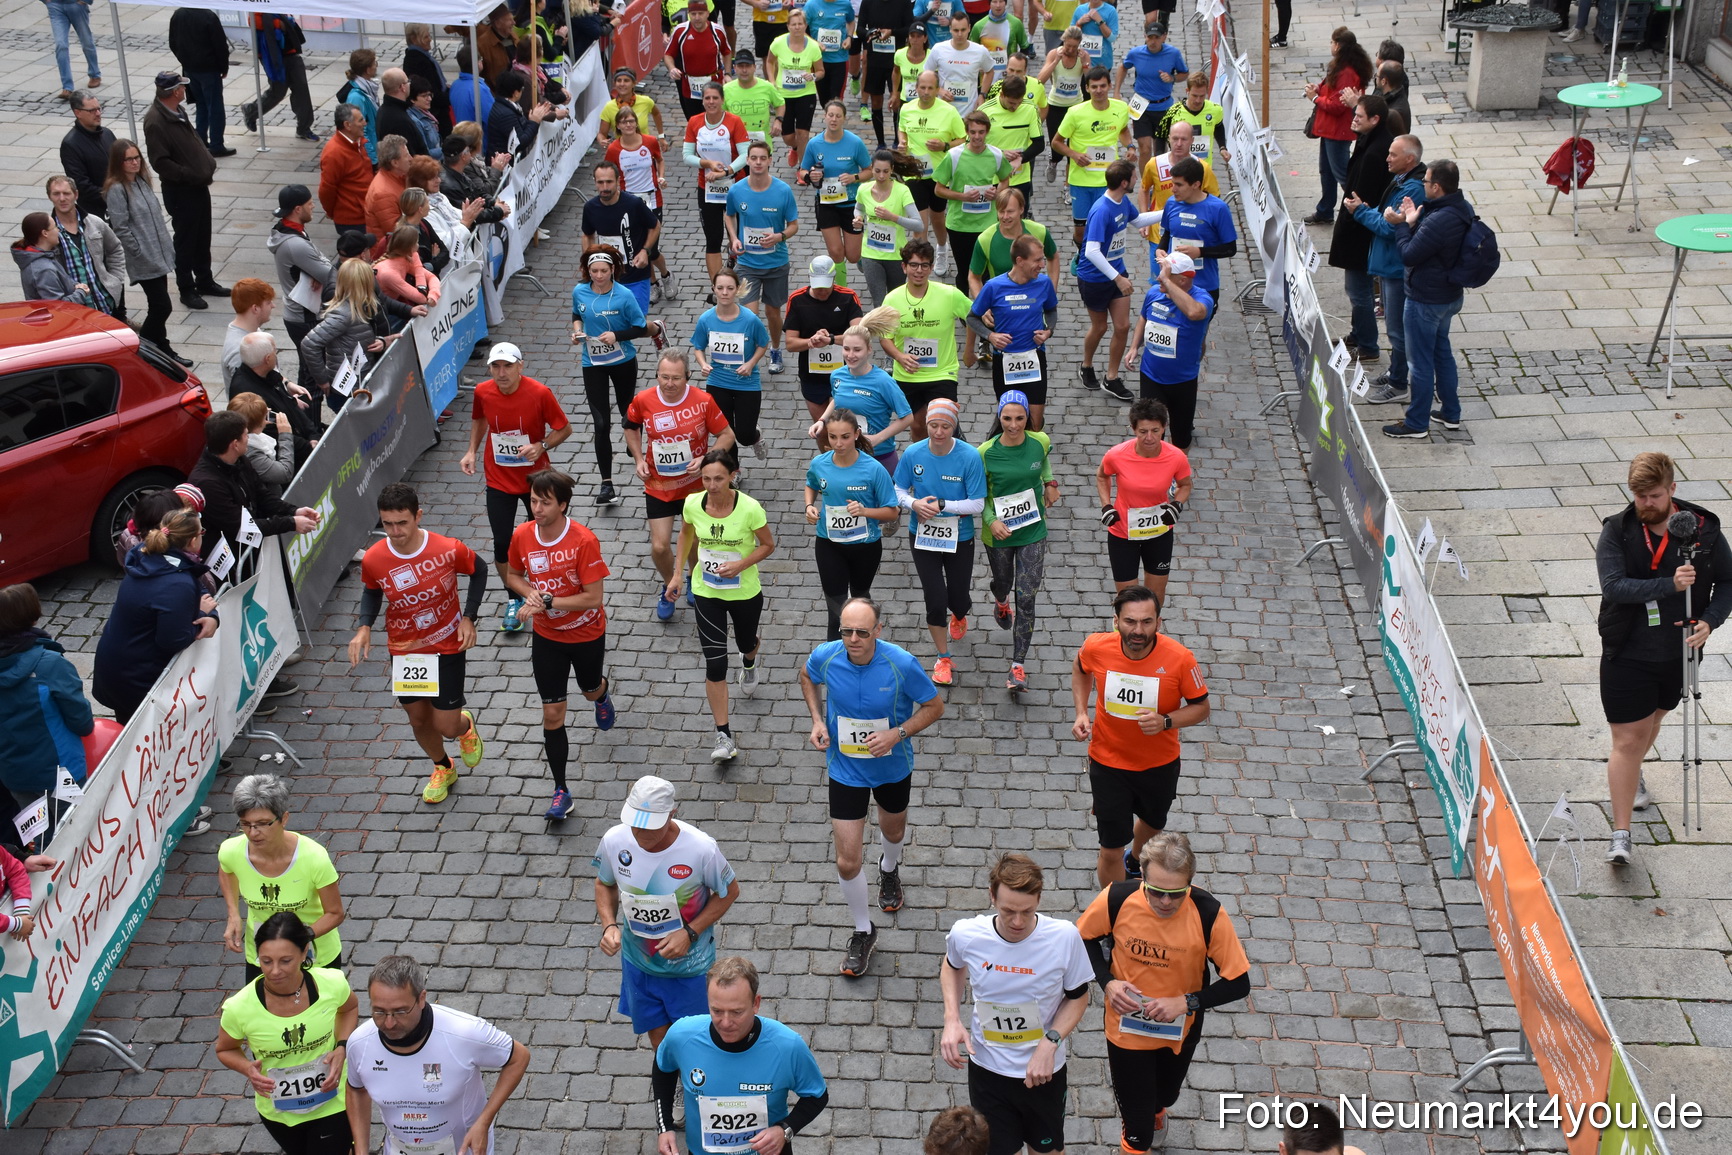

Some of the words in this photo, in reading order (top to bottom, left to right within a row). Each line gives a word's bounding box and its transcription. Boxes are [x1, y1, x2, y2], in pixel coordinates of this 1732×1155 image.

[821, 35, 838, 44] 2583
[1082, 41, 1099, 50] 2912
[785, 75, 803, 84] 2308
[1095, 152, 1106, 161] 94
[827, 185, 838, 194] 52
[869, 231, 892, 242] 2094
[1148, 332, 1171, 346] 2398
[713, 341, 740, 354] 2712
[908, 344, 933, 356] 2530
[819, 352, 833, 365] 90
[1007, 361, 1035, 373] 2412
[338, 371, 351, 390] swn
[658, 452, 685, 465] 2071
[1002, 500, 1031, 518] 2760
[831, 516, 859, 529] 2027
[1137, 514, 1159, 528] 270
[923, 524, 952, 538] 2753
[212, 551, 227, 572] swn
[421, 626, 453, 645] raumbox
[403, 667, 429, 681] 232
[1116, 687, 1143, 704] 401
[20, 815, 37, 835] swn
[631, 906, 672, 923] 2382
[91, 907, 142, 993] Service-Line:
[1130, 943, 1170, 962] OEXL
[1530, 921, 1553, 971] Neumarkts
[994, 965, 1037, 975] KLEBL
[993, 1016, 1028, 1031] 112
[1142, 1023, 1160, 1033] Franz
[1002, 1033, 1023, 1042] Marco
[279, 1072, 327, 1097] 2196
[739, 1083, 773, 1091] BOCK
[298, 1097, 316, 1106] Ilona
[709, 1112, 758, 1131] 2922
